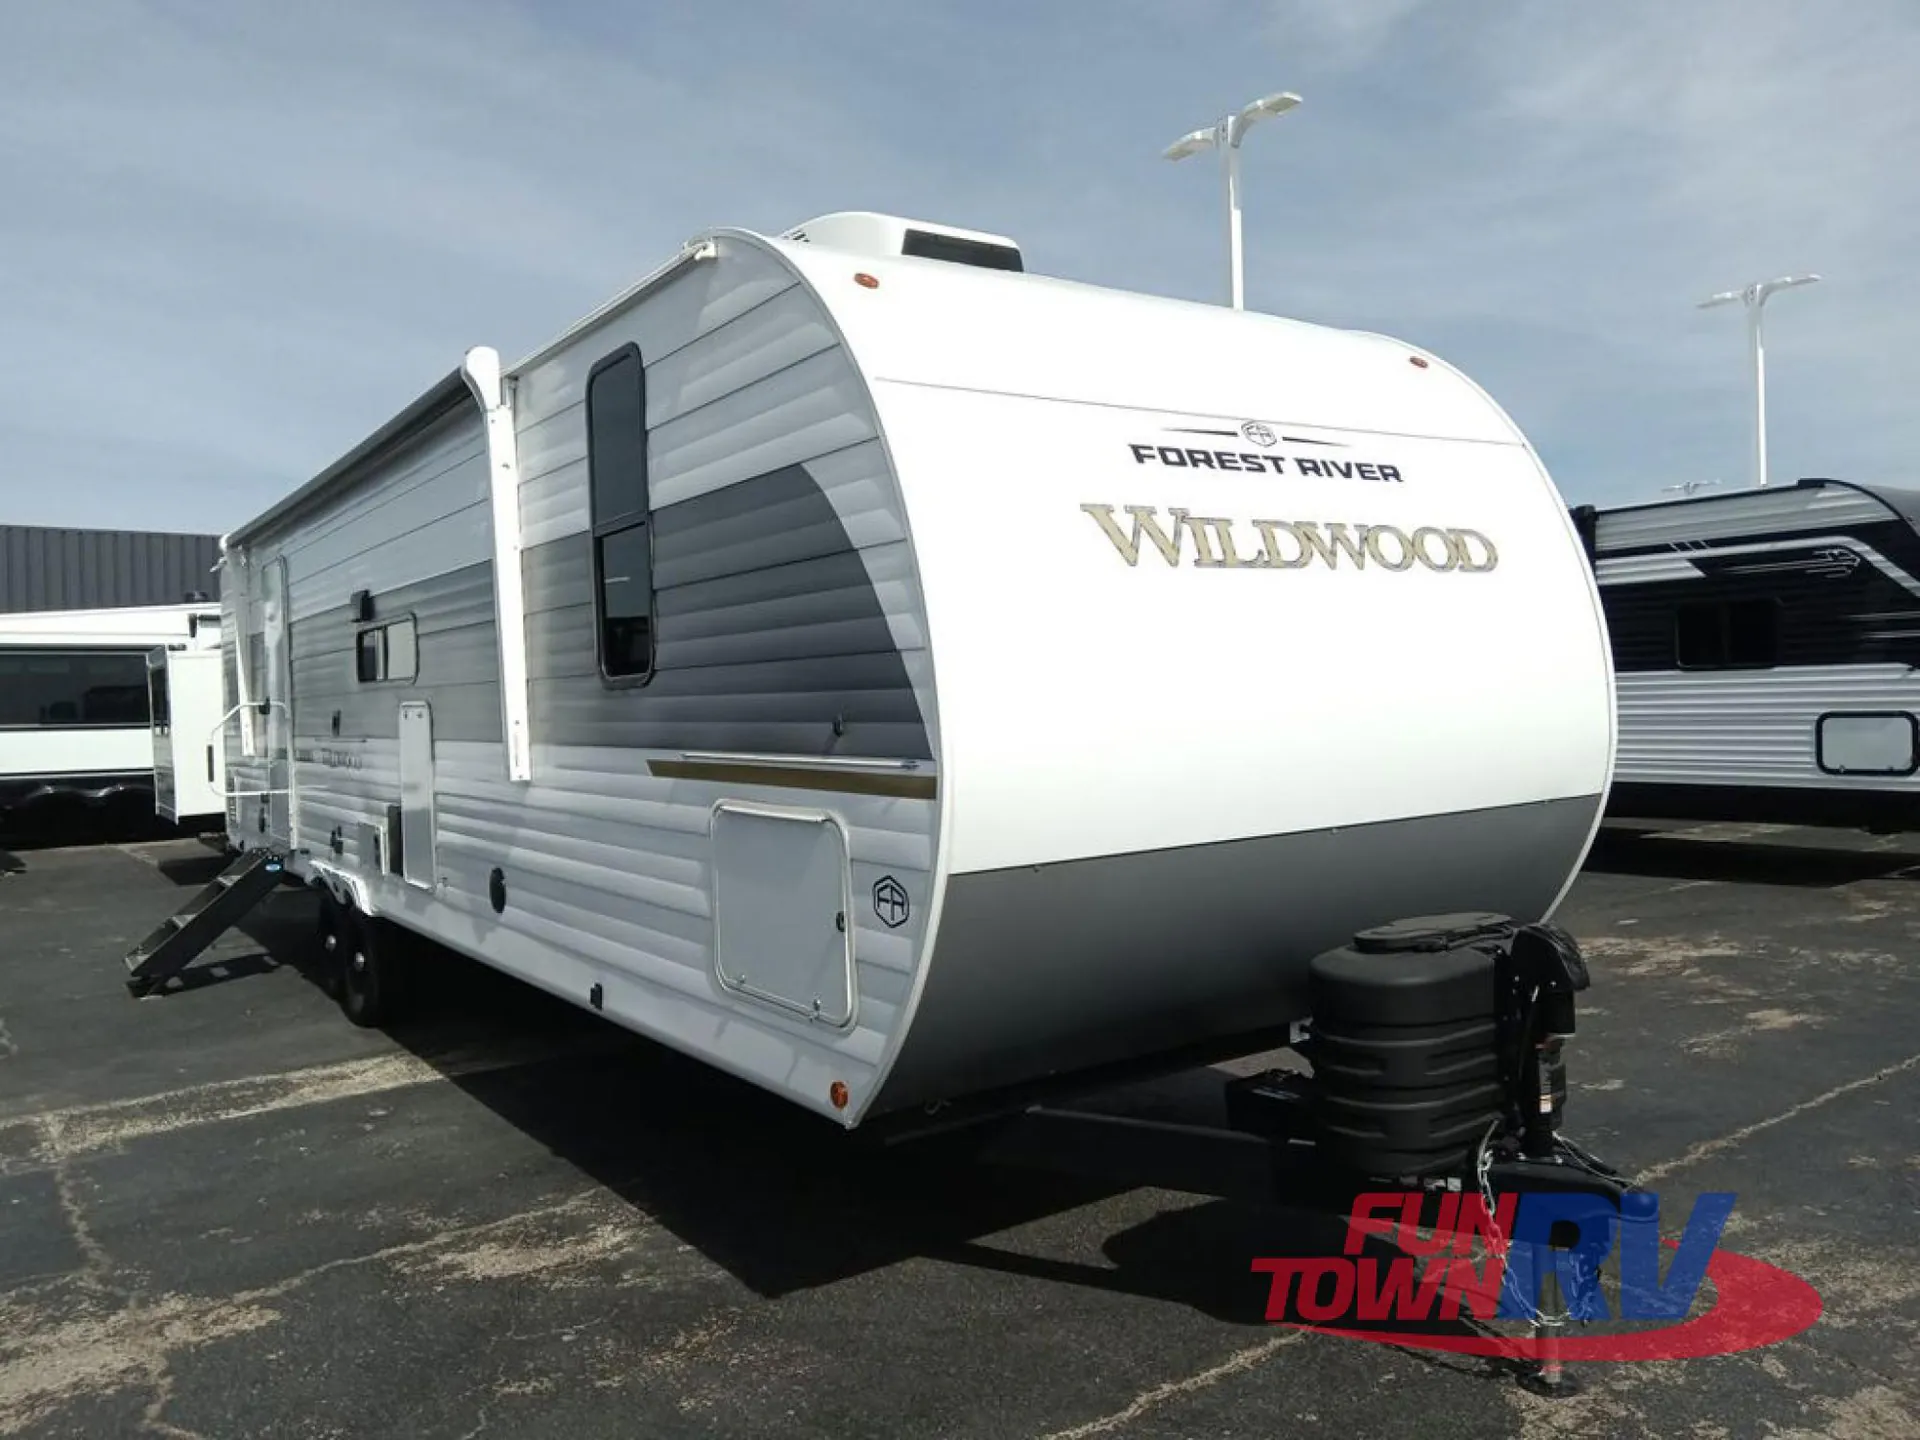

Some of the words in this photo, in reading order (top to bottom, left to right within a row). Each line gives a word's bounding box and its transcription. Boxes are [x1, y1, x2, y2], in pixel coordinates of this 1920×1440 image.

[1128, 444, 1286, 474] FOREST
[1293, 457, 1405, 482] RIVER
[1080, 503, 1498, 572] WILDWOOD
